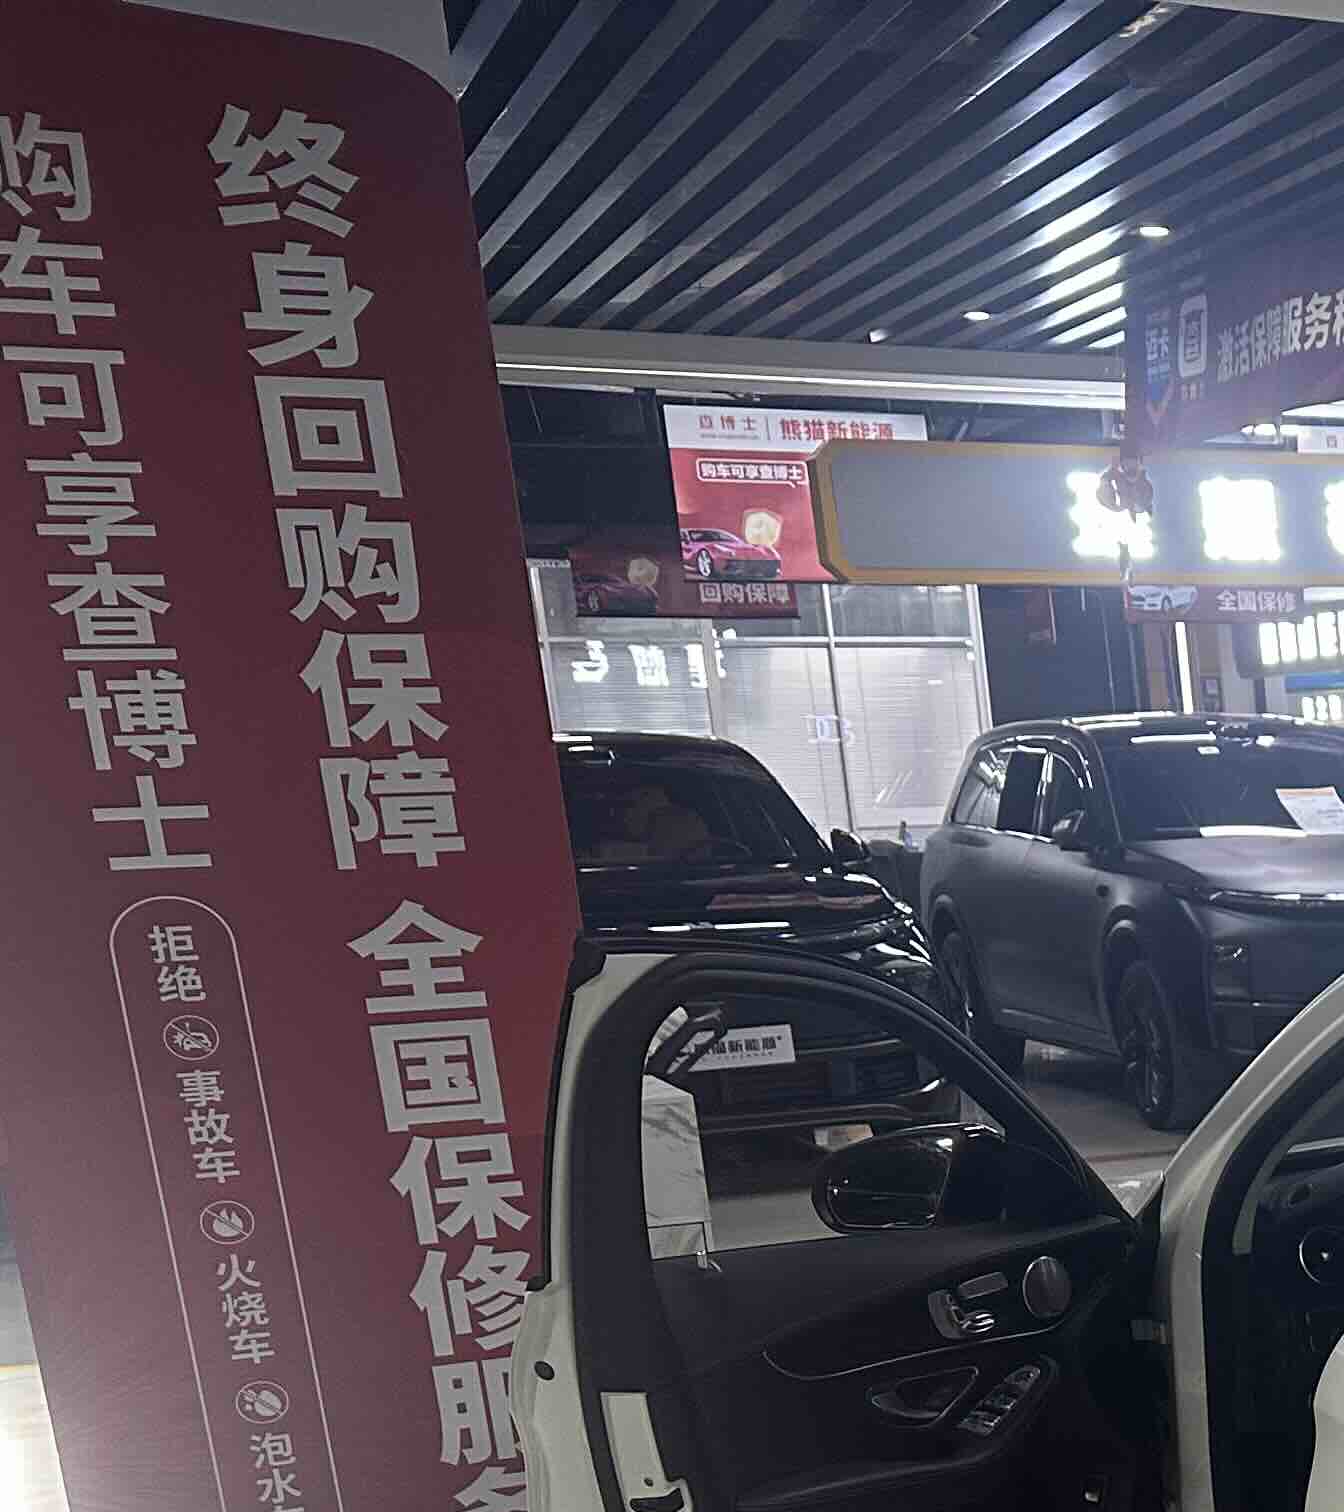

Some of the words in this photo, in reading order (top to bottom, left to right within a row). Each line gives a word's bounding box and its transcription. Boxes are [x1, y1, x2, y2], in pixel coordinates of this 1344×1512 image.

[0, 112, 213, 872] 购车可享查博士
[207, 104, 467, 871] 终身回购保障
[701, 462, 803, 480] 购车可享查博士
[1216, 589, 1297, 614] 全国保修
[147, 924, 207, 1005] 拒绝
[175, 1068, 242, 1185] 事故车
[215, 1253, 276, 1367] 火烧车
